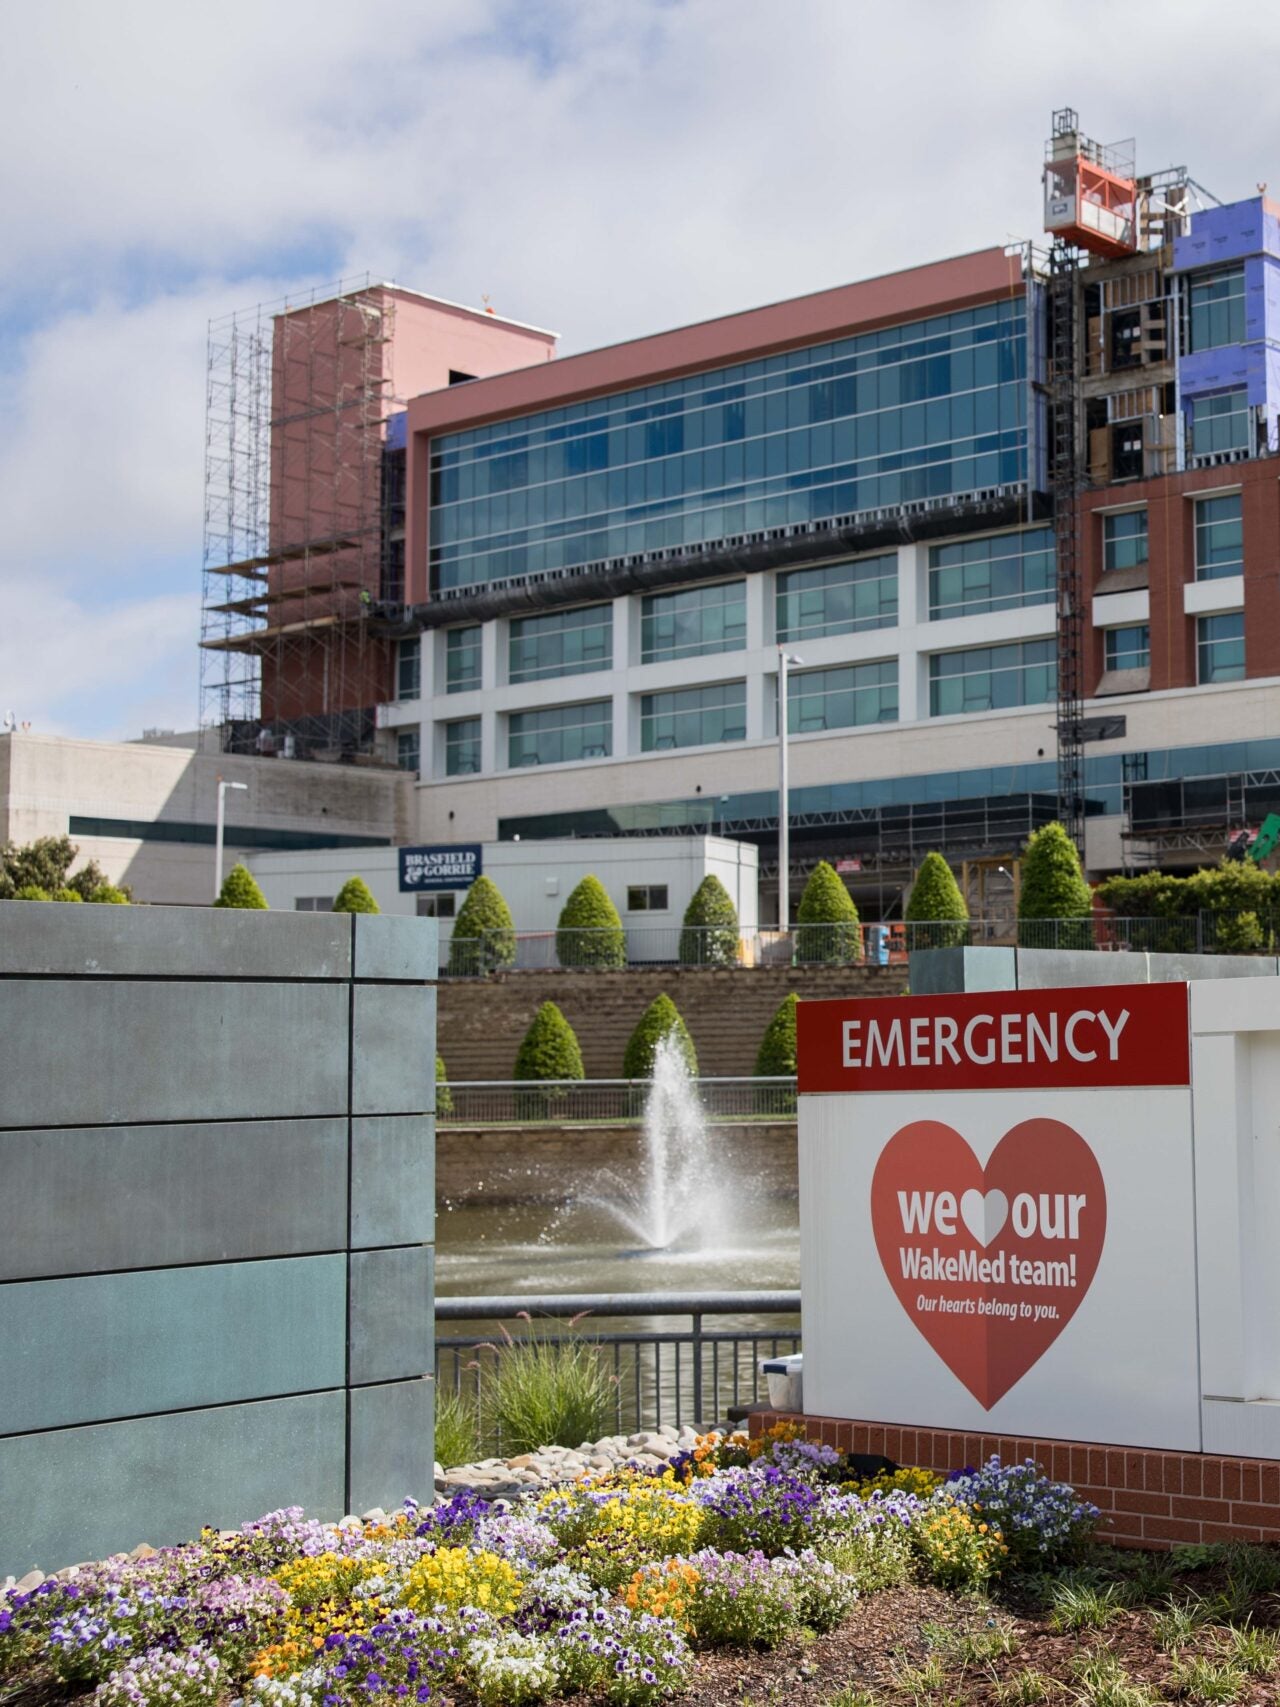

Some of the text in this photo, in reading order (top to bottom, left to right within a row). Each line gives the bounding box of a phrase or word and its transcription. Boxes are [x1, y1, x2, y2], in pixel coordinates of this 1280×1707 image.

[405, 852, 476, 866] BRASFIELD
[424, 863, 475, 876] GORRIE
[842, 1009, 1130, 1068] EMERGENCY
[897, 1191, 1086, 1240] we our
[899, 1247, 1077, 1288] WakeMed team!
[916, 1294, 1060, 1322] Our hearts belong to you.
